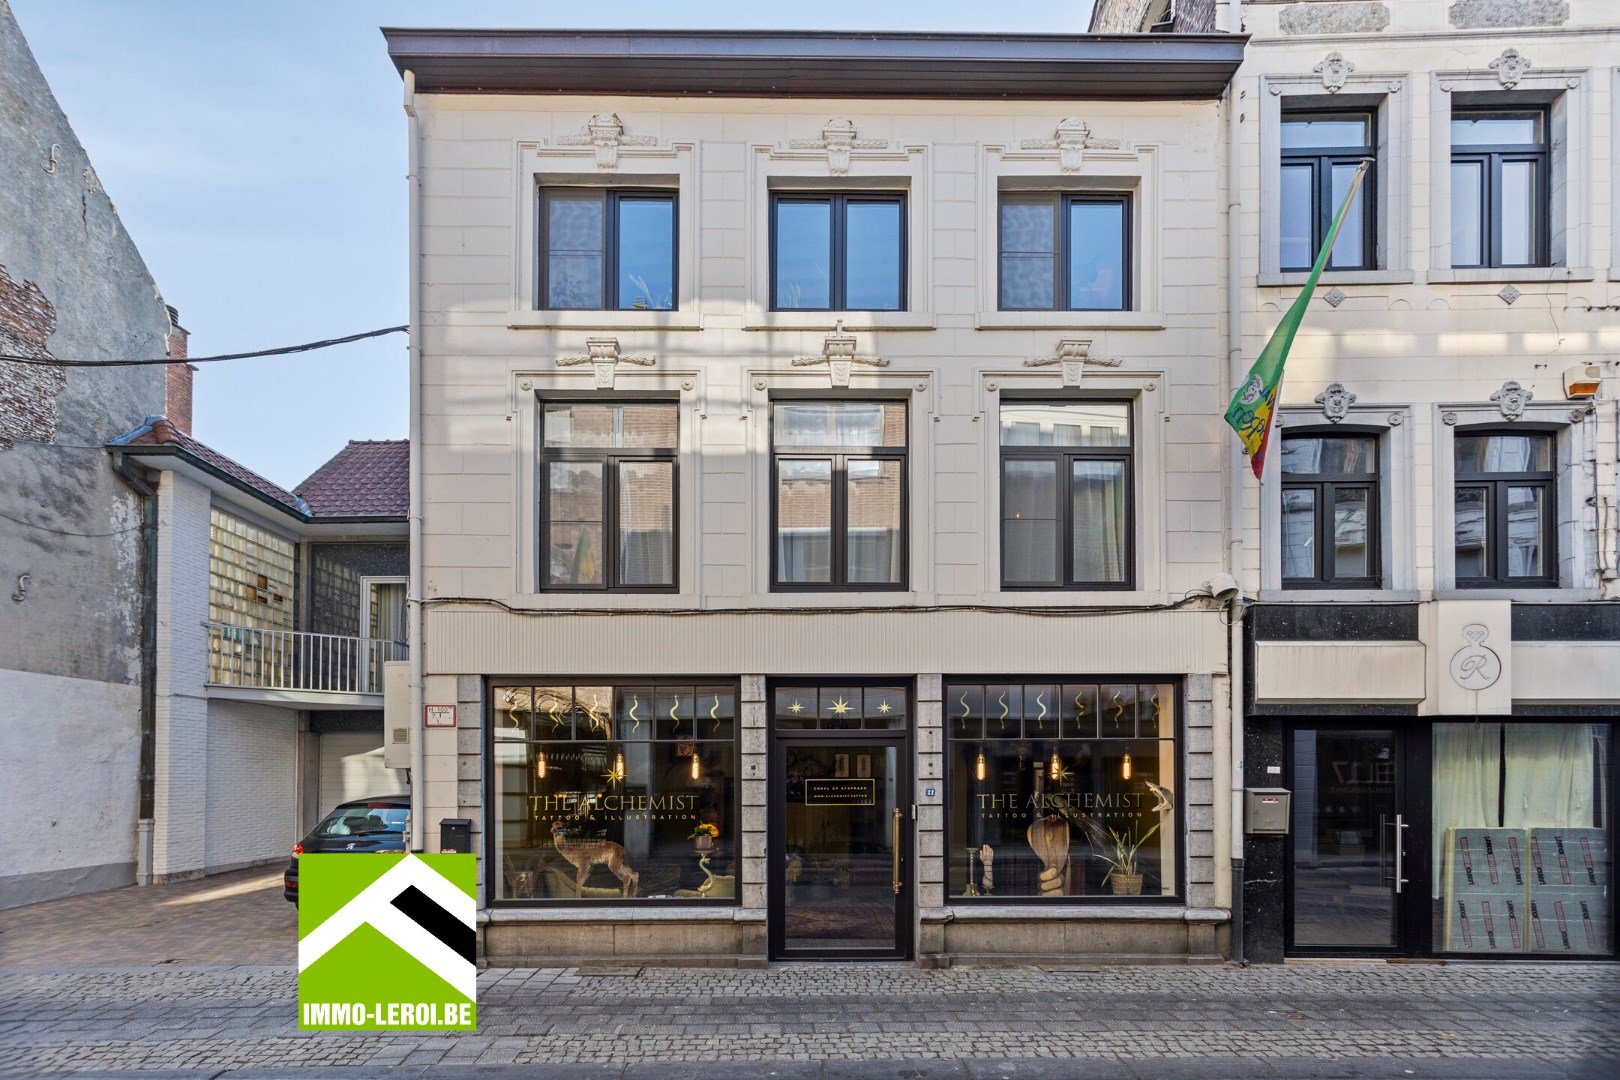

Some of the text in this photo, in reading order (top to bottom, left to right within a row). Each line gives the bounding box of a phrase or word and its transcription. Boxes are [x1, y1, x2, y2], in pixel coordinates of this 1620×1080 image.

[1460, 654, 1490, 680] R
[529, 795, 699, 811] THE ALCHEMIST
[976, 792, 1145, 809] THE ALCHEMIST
